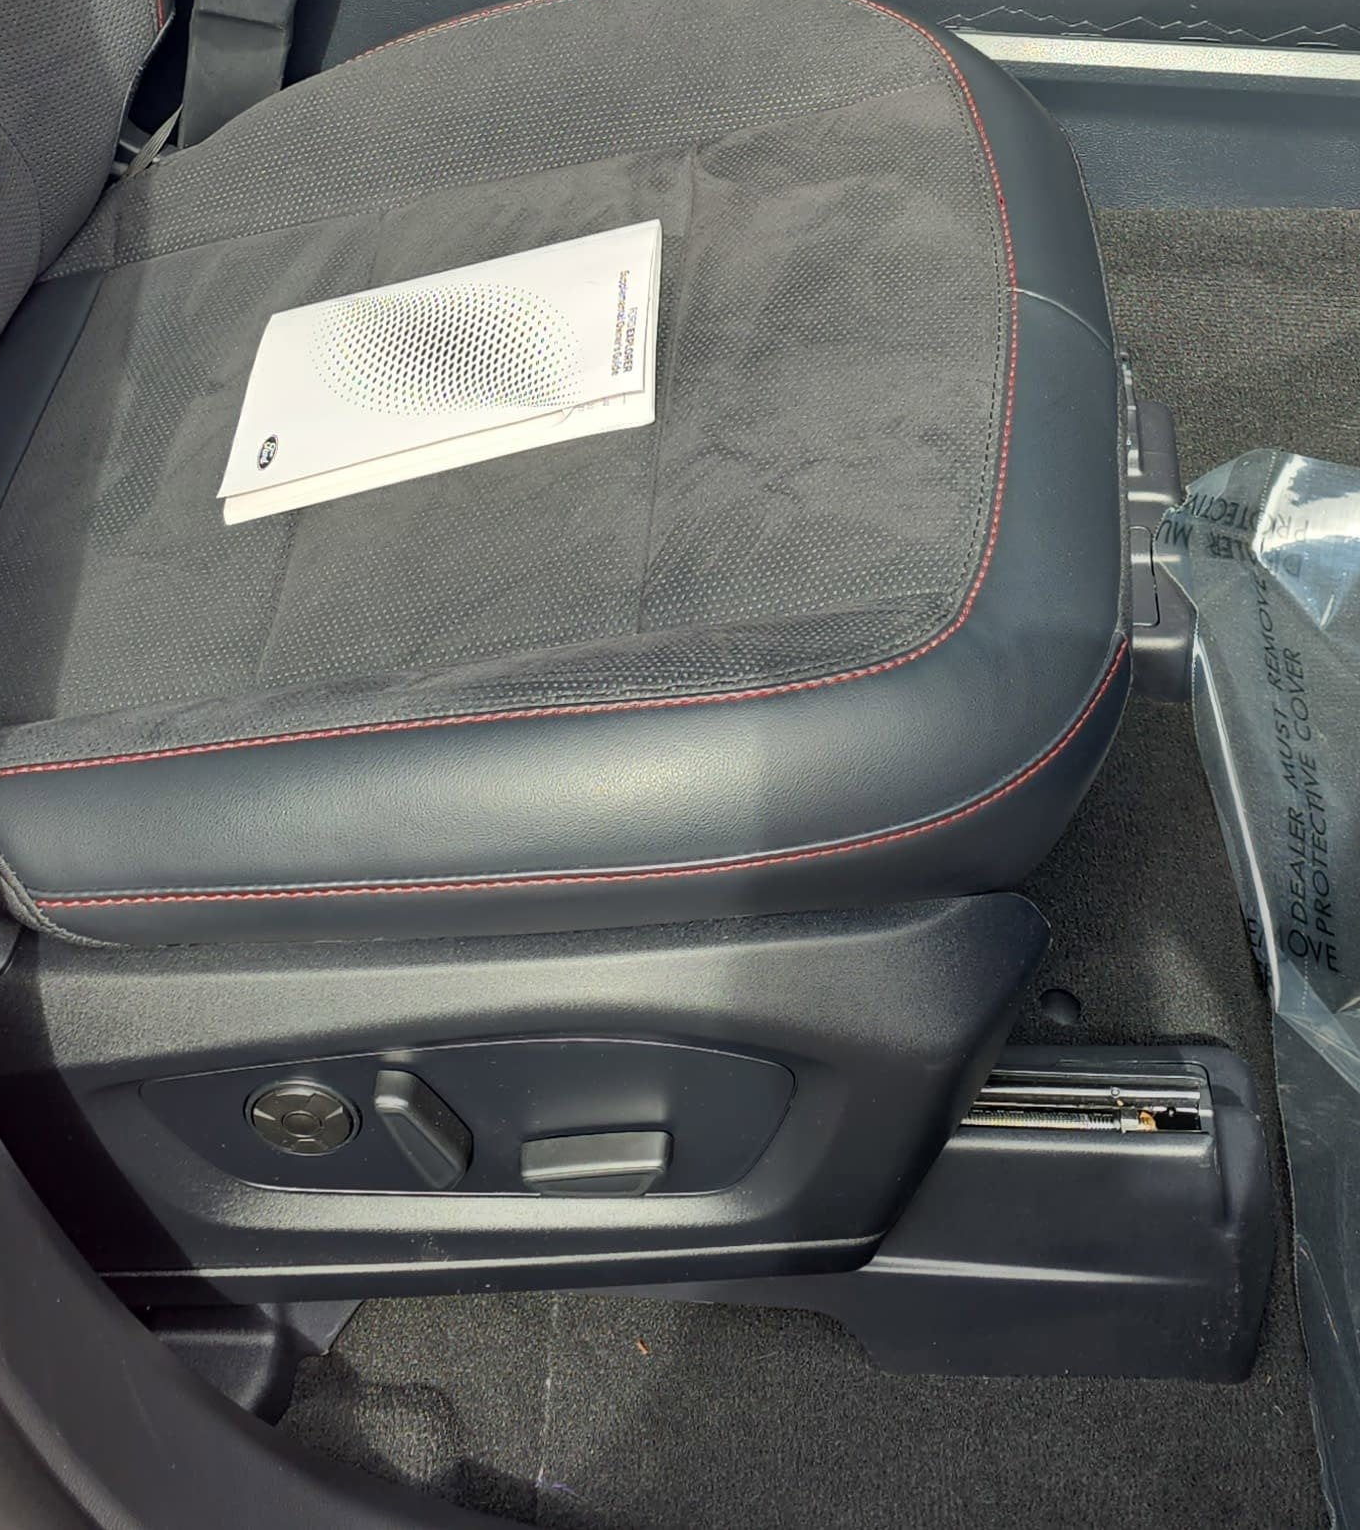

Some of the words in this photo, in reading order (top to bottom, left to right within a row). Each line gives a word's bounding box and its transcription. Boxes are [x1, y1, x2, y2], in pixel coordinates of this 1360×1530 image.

[1255, 576, 1283, 691] REMOVE
[1273, 701, 1299, 790] MUST
[1283, 647, 1312, 742] COVER
[1288, 806, 1308, 925] DEALER
[1299, 751, 1336, 937] PROTECTIVE
